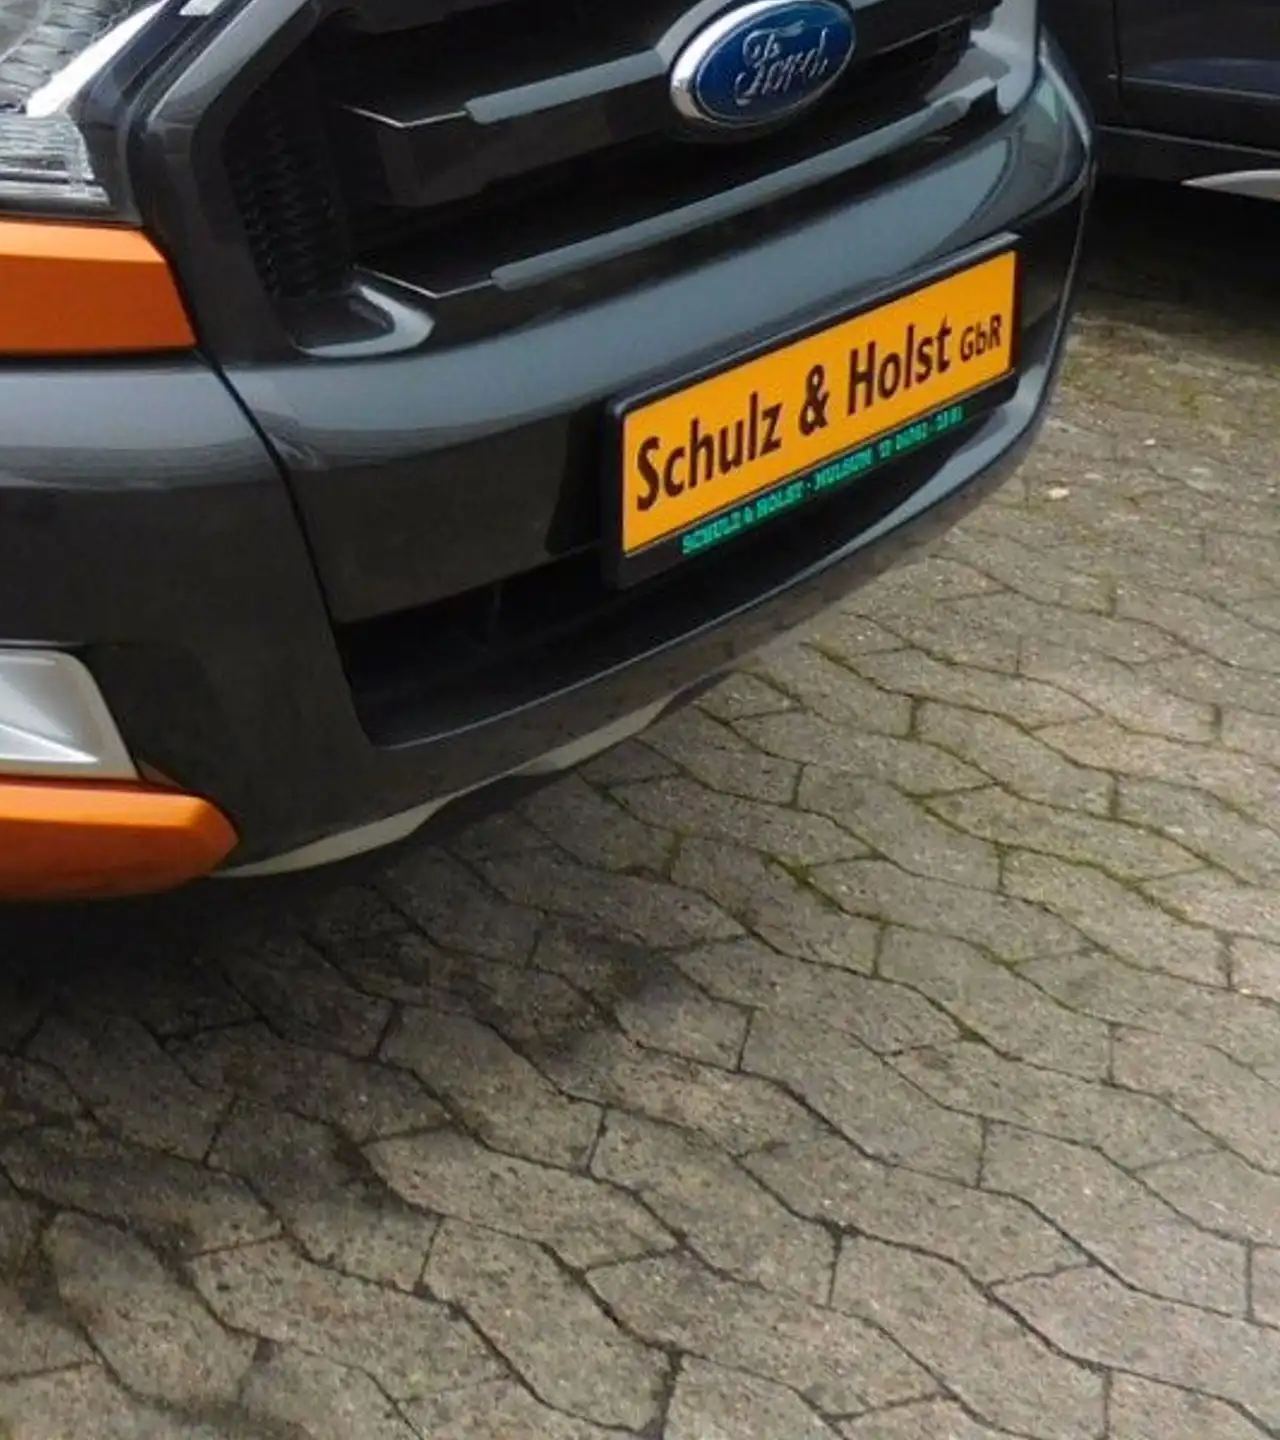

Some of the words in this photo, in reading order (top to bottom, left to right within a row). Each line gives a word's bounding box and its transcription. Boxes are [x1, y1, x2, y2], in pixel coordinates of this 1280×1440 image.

[736, 20, 830, 107] Ford
[636, 391, 782, 511] Schulz
[798, 364, 829, 437] &
[847, 316, 952, 415] Holst
[960, 313, 1002, 363] GbR
